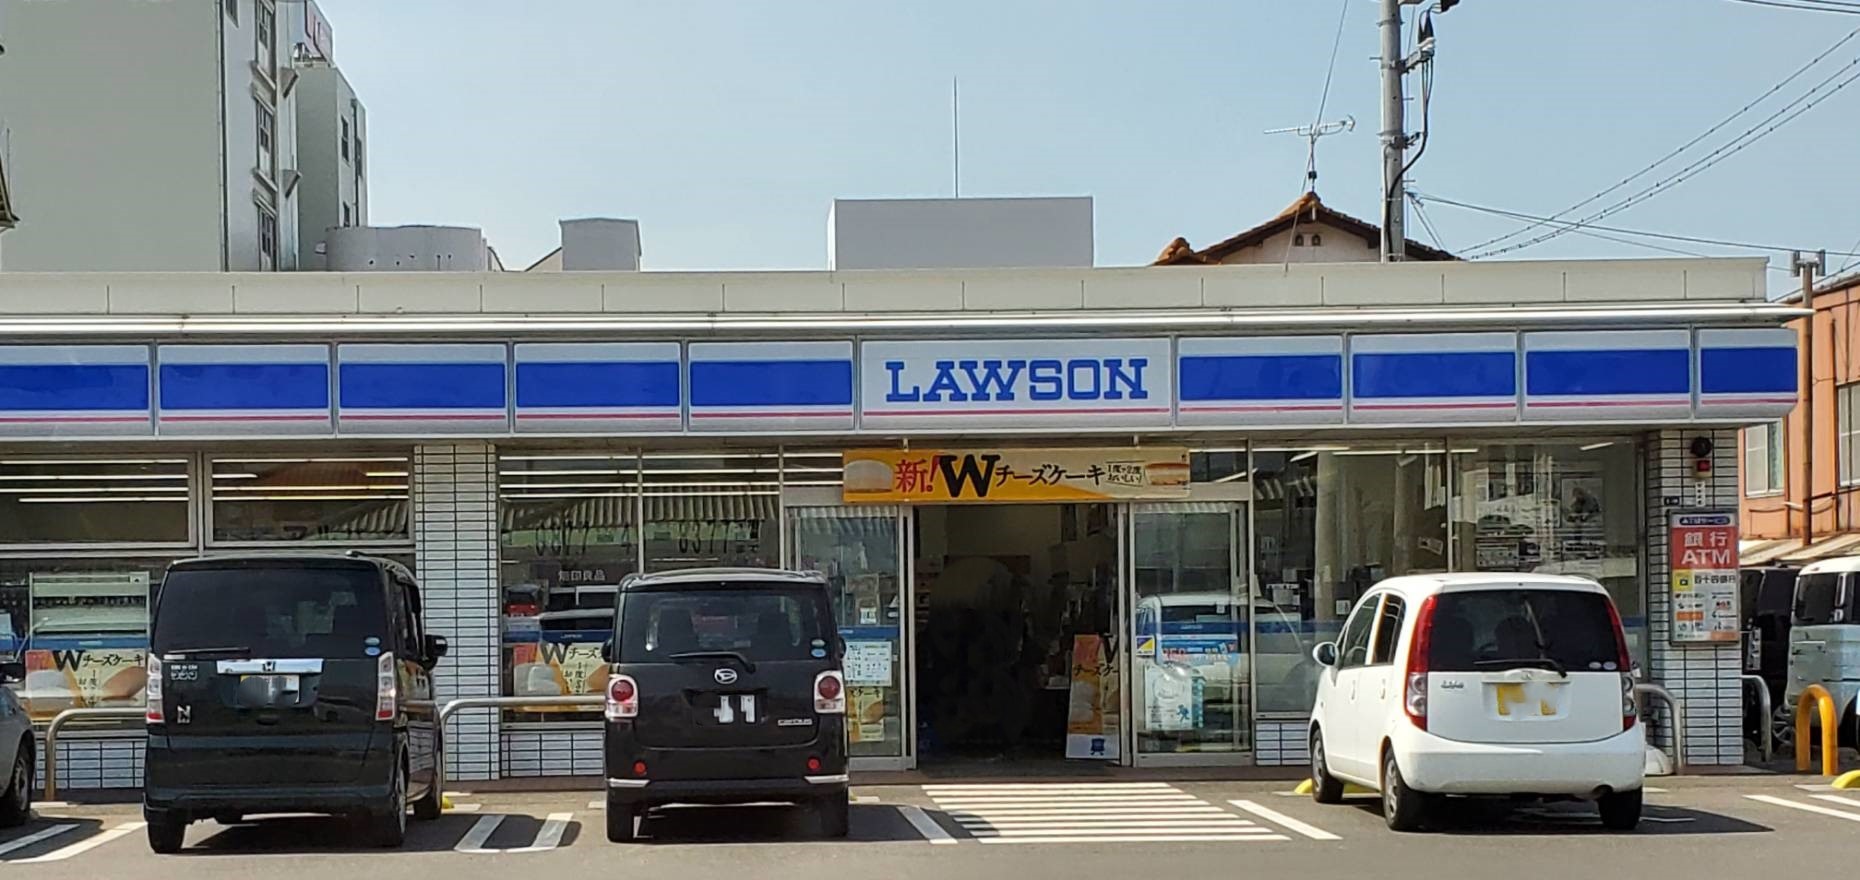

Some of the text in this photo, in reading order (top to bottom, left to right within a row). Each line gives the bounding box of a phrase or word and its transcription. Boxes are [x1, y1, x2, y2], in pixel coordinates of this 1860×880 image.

[885, 358, 1149, 402] LAWSON
[1684, 531, 1728, 548] 銀行
[1681, 549, 1730, 565] ATM
